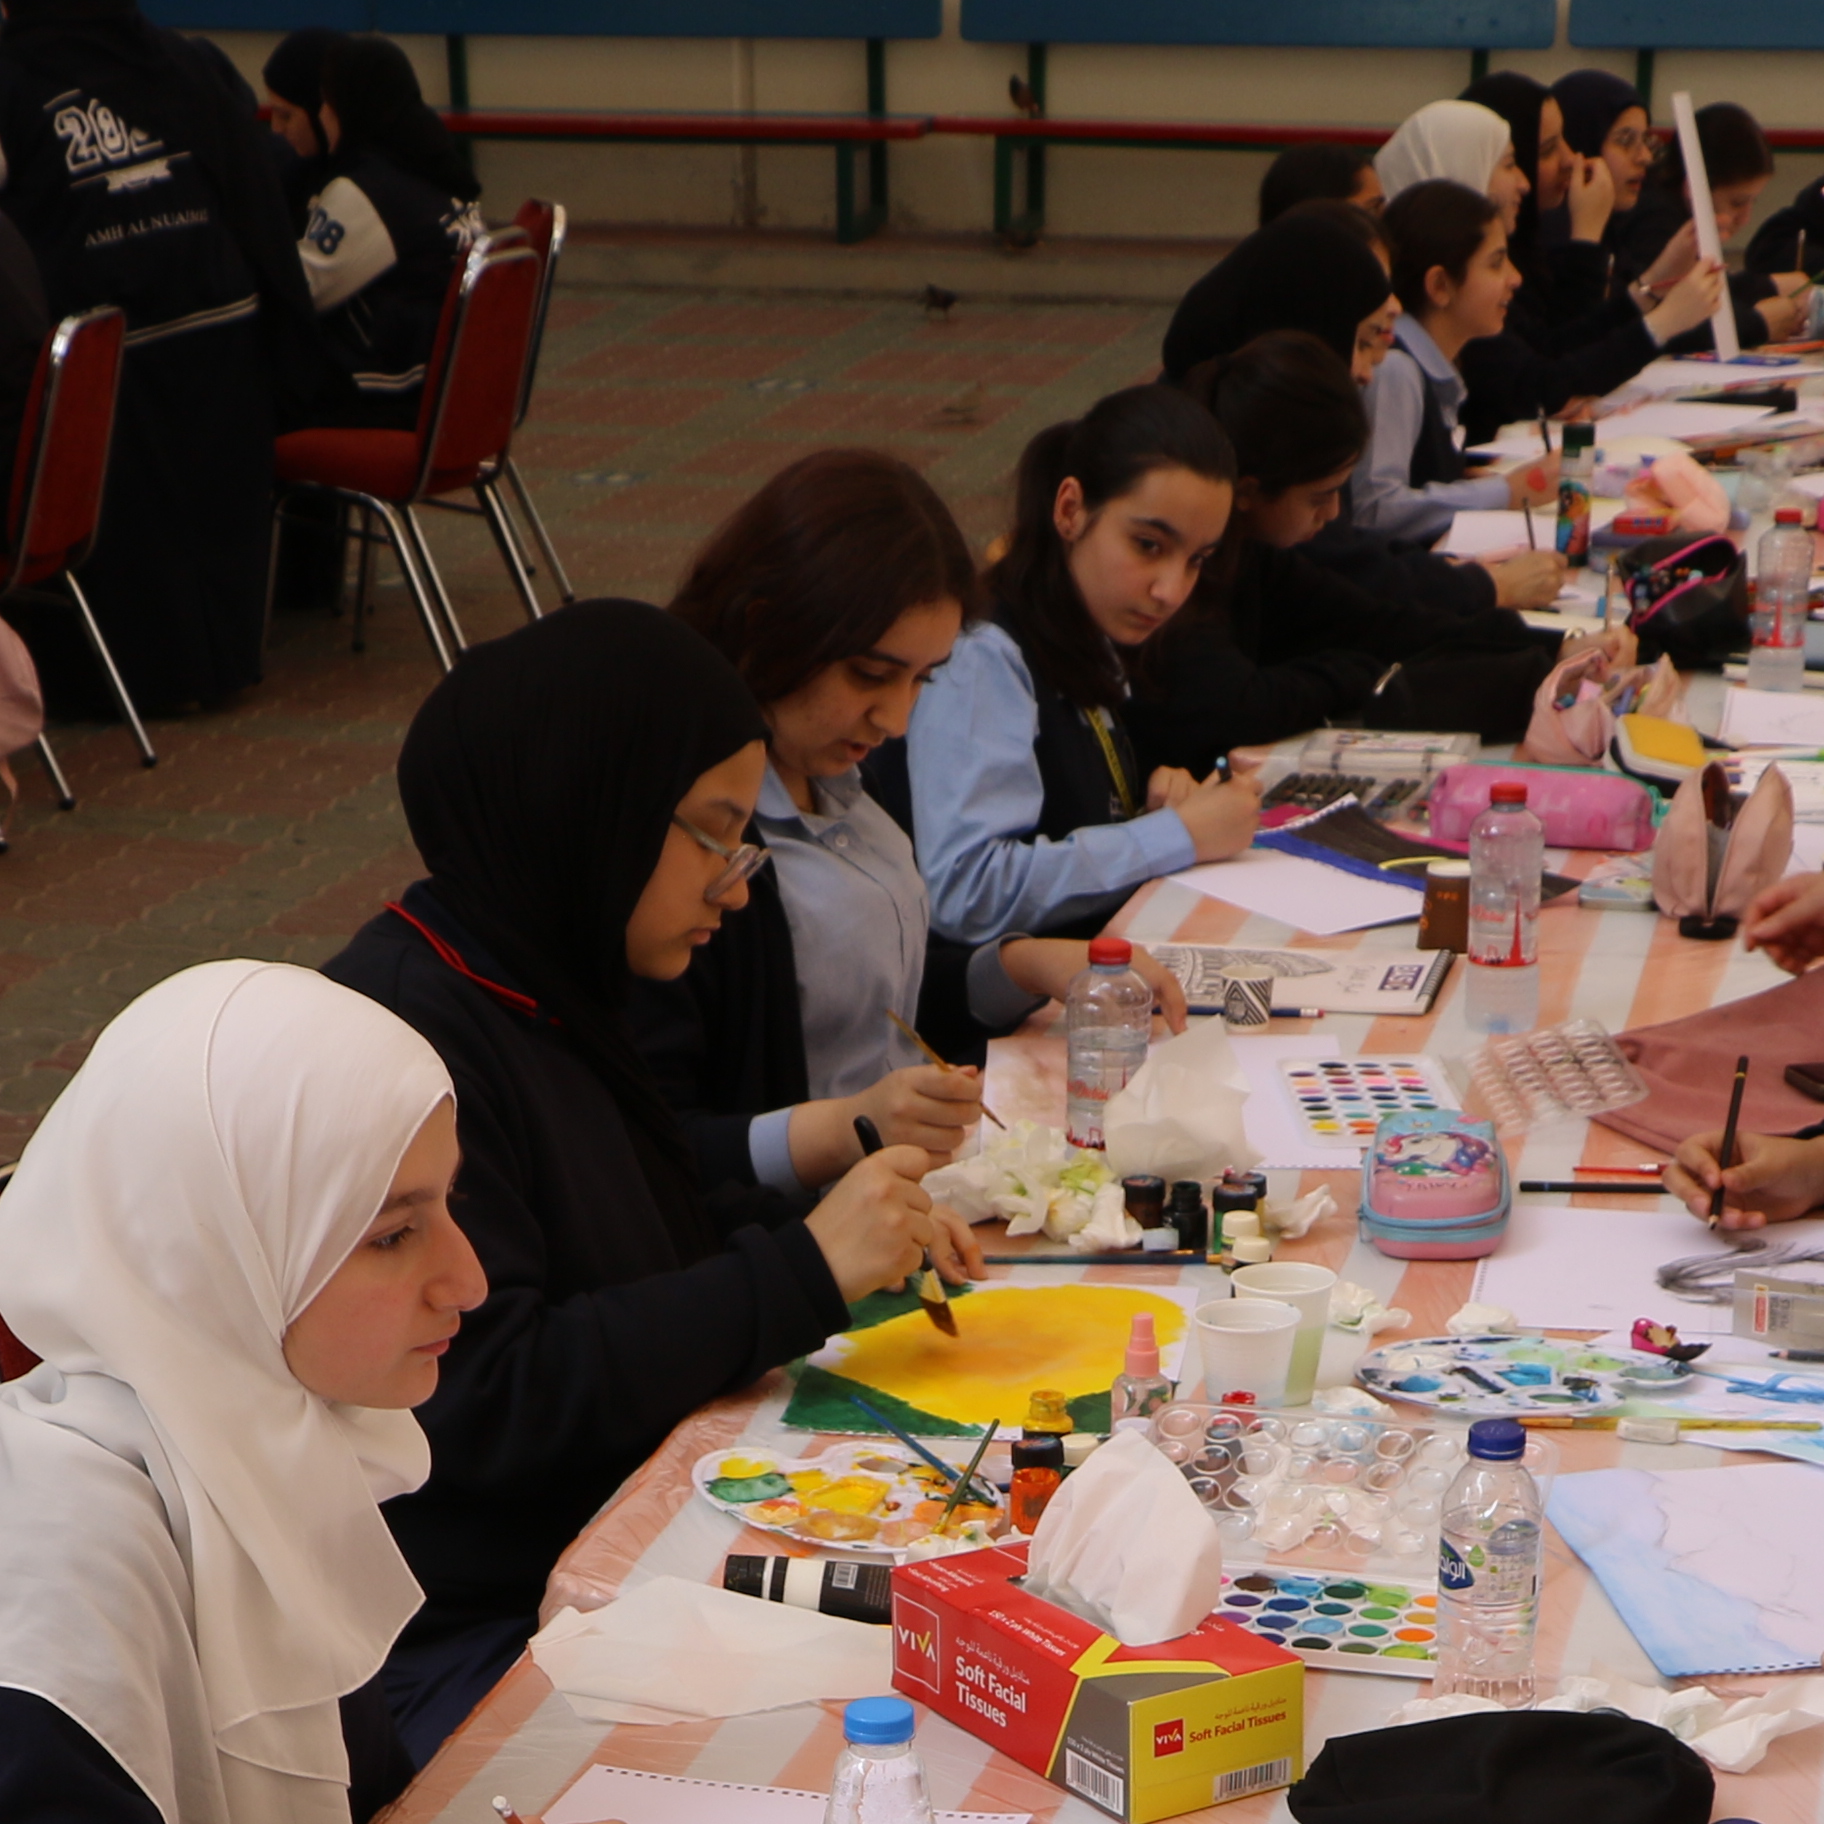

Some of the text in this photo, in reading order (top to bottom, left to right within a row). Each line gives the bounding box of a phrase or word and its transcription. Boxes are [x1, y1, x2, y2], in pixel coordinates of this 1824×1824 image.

[898, 1625, 936, 1662] VIVA
[956, 1656, 1026, 1713] Soft Facial
[956, 1681, 1007, 1727] Tissues
[1155, 1728, 1182, 1745] VIVA
[1189, 1711, 1287, 1743] Soft Facial Tissues
